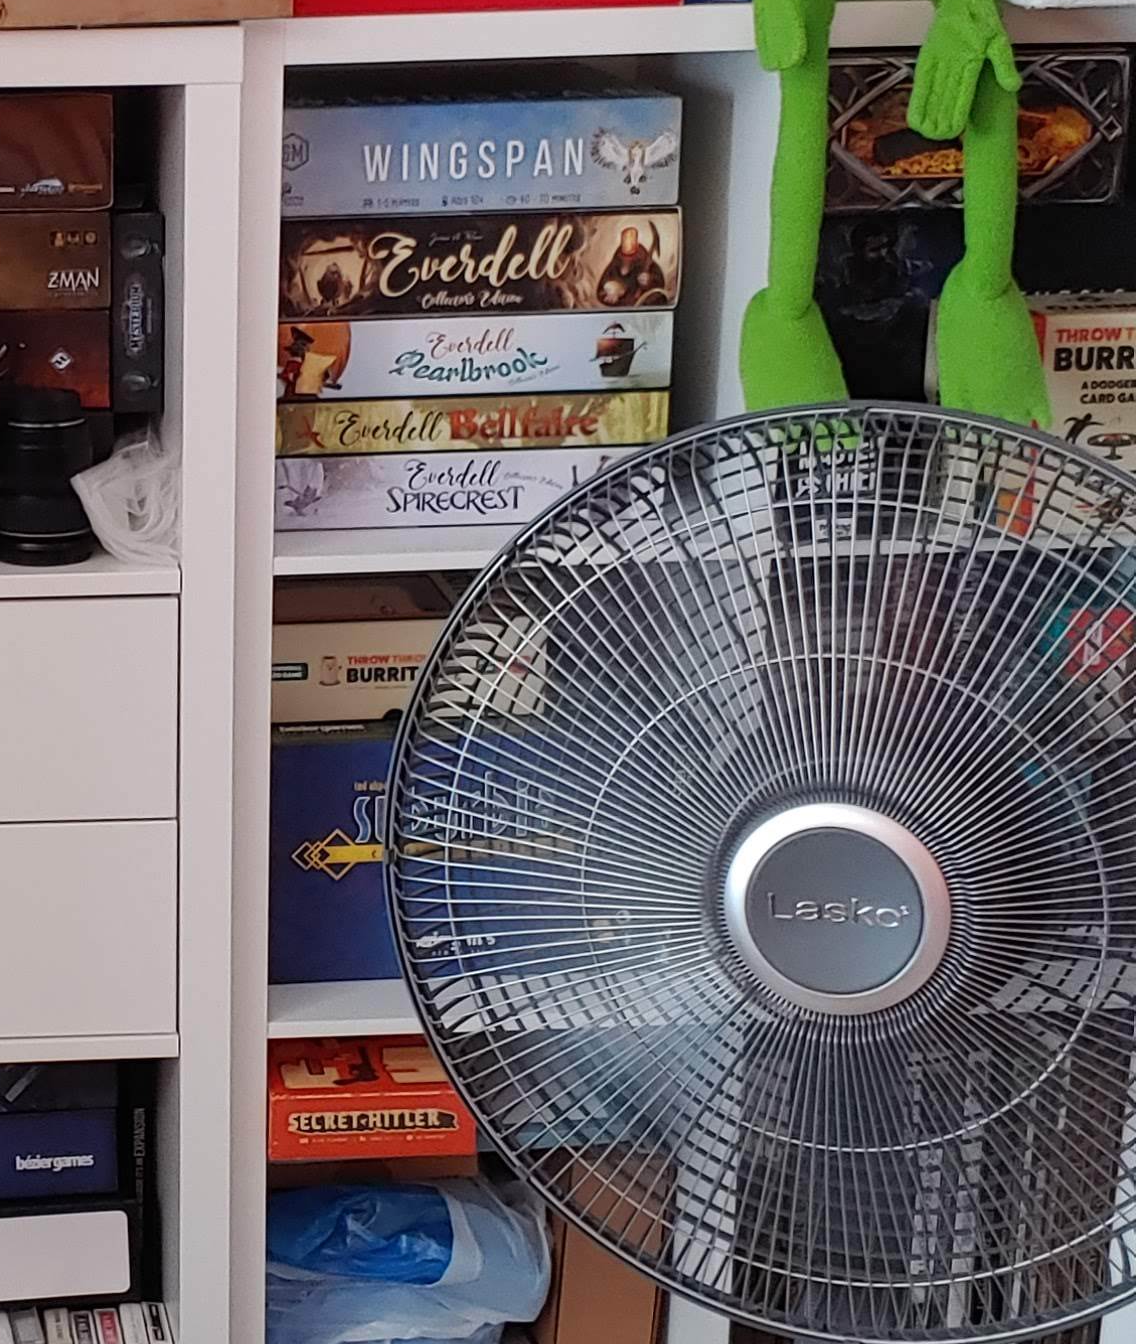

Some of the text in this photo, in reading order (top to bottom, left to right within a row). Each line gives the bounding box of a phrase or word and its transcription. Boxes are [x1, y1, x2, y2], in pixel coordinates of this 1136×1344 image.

[364, 138, 585, 182] WINGSPAN
[367, 223, 574, 299] Everdell
[426, 327, 515, 360] Everdell
[1055, 327, 1123, 343] THROW
[389, 347, 549, 384] Pearlbrook
[1080, 392, 1116, 405] CARD
[334, 405, 600, 448] Everdell Bellfaire
[404, 458, 502, 492] Everdell
[385, 485, 526, 516] SPIRECREST
[346, 666, 419, 683] BURRIT
[347, 655, 389, 667] THROW
[767, 891, 902, 928] Lasko
[287, 1109, 442, 1132] SECRET HITLER
